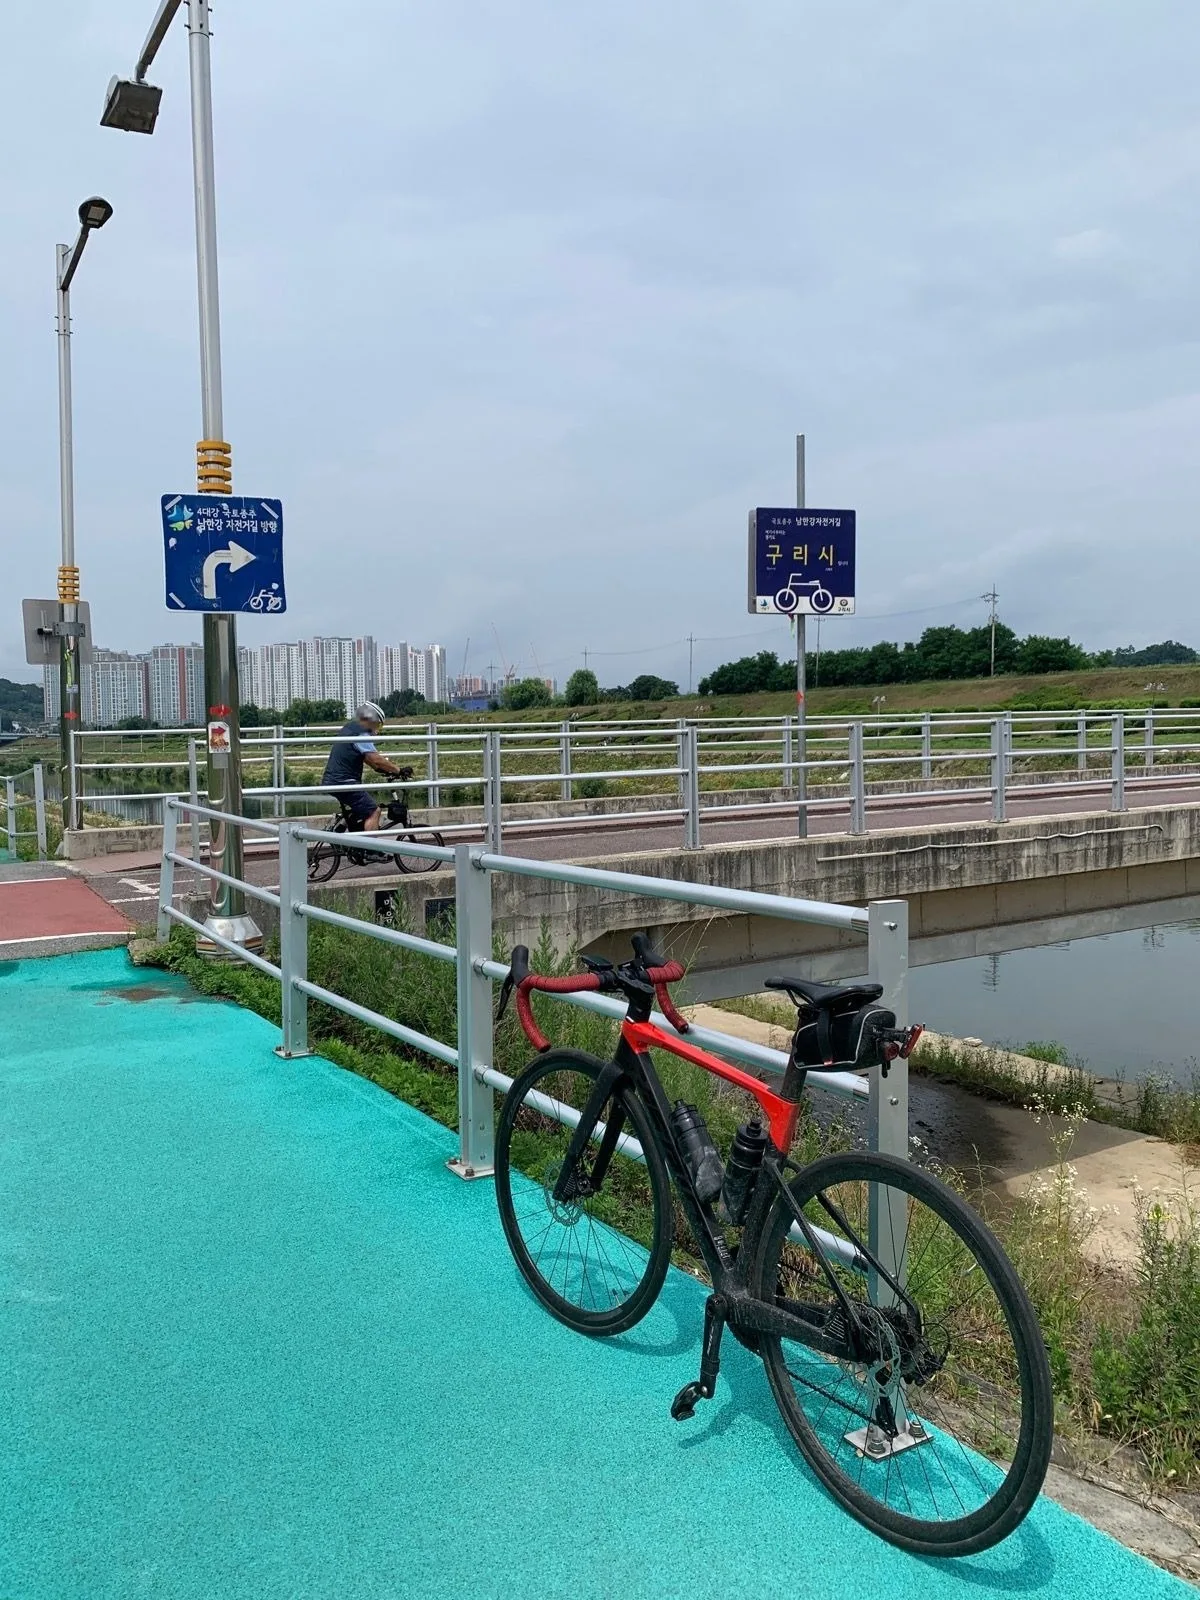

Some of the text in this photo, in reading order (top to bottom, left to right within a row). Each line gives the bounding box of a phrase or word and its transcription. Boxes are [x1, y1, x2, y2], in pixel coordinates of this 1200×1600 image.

[197, 507, 257, 519] 4대강 국토종주
[197, 518, 277, 533] 남한강 자전거길 방향
[795, 516, 841, 527] 남한강자전거길
